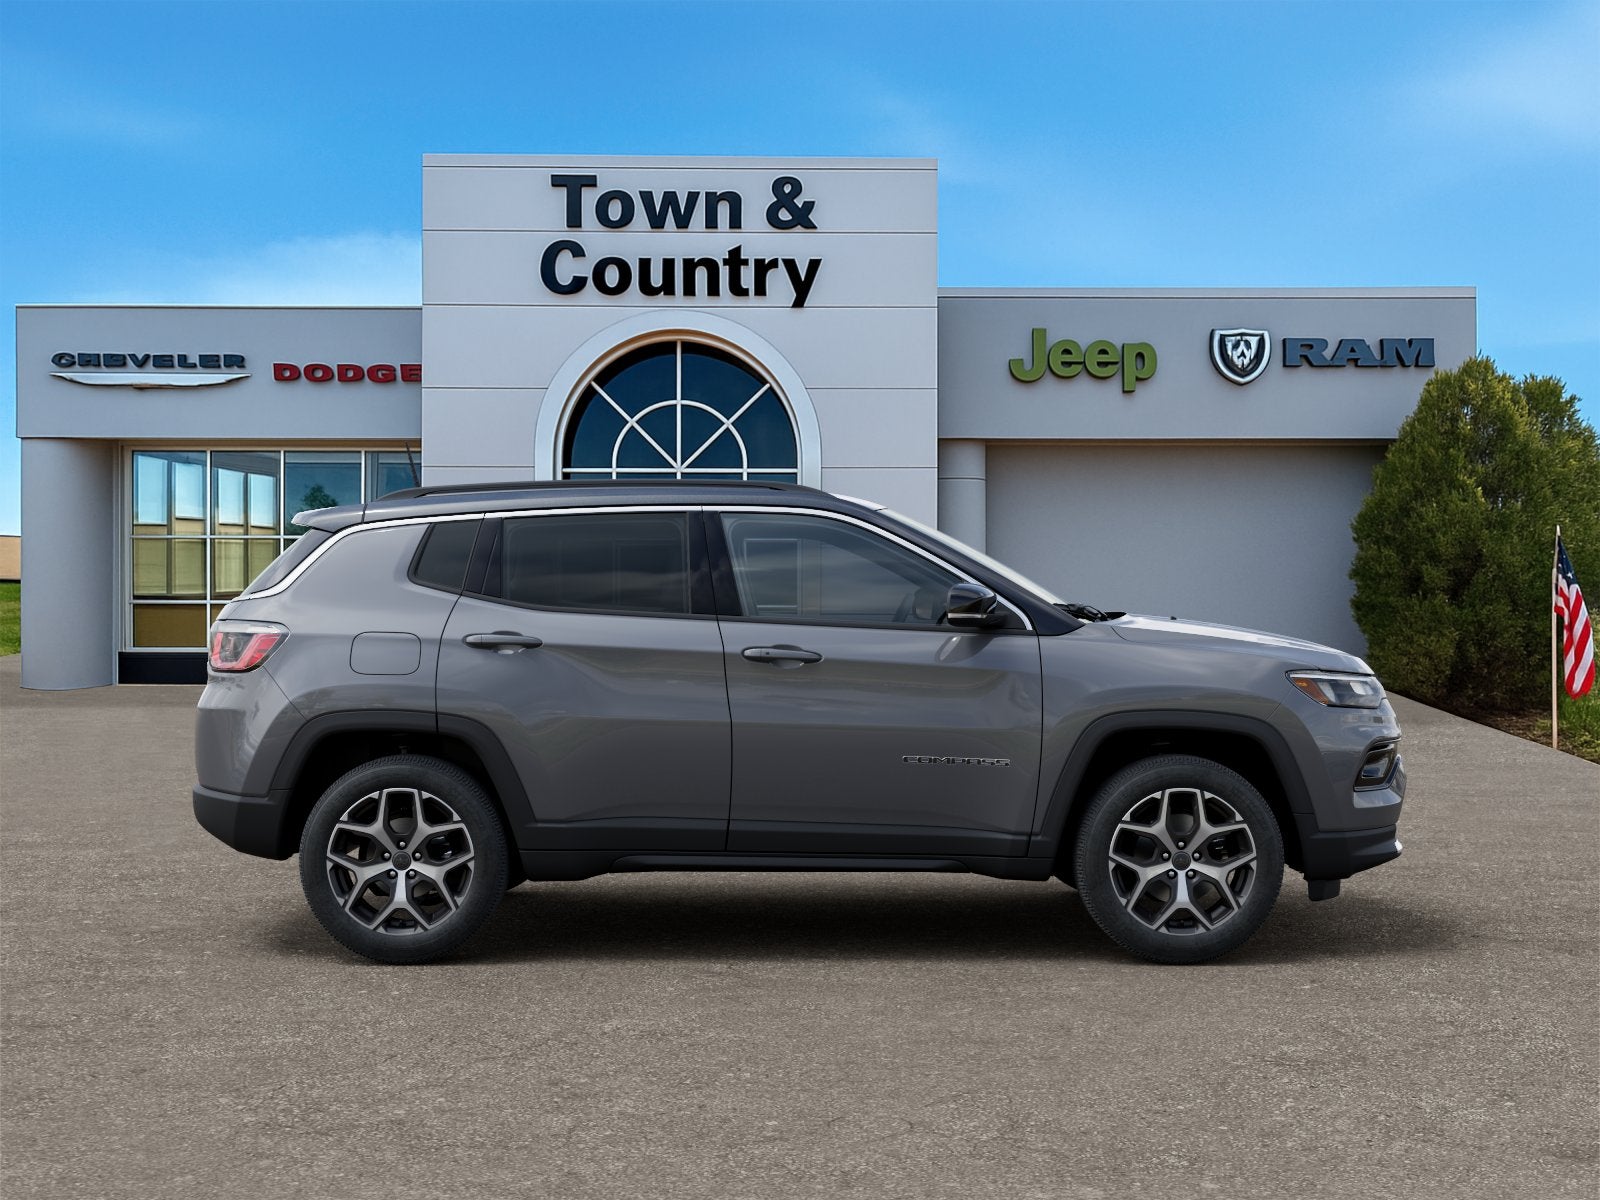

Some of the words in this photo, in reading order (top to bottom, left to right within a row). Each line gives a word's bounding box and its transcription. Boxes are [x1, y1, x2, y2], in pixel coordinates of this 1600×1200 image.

[550, 174, 742, 229] Town
[765, 175, 818, 230] &
[540, 239, 822, 308] Country
[273, 362, 422, 384] DODGE
[1009, 328, 1158, 393] Jeep
[1282, 337, 1435, 368] RAM
[902, 755, 1011, 767] COMPASS
